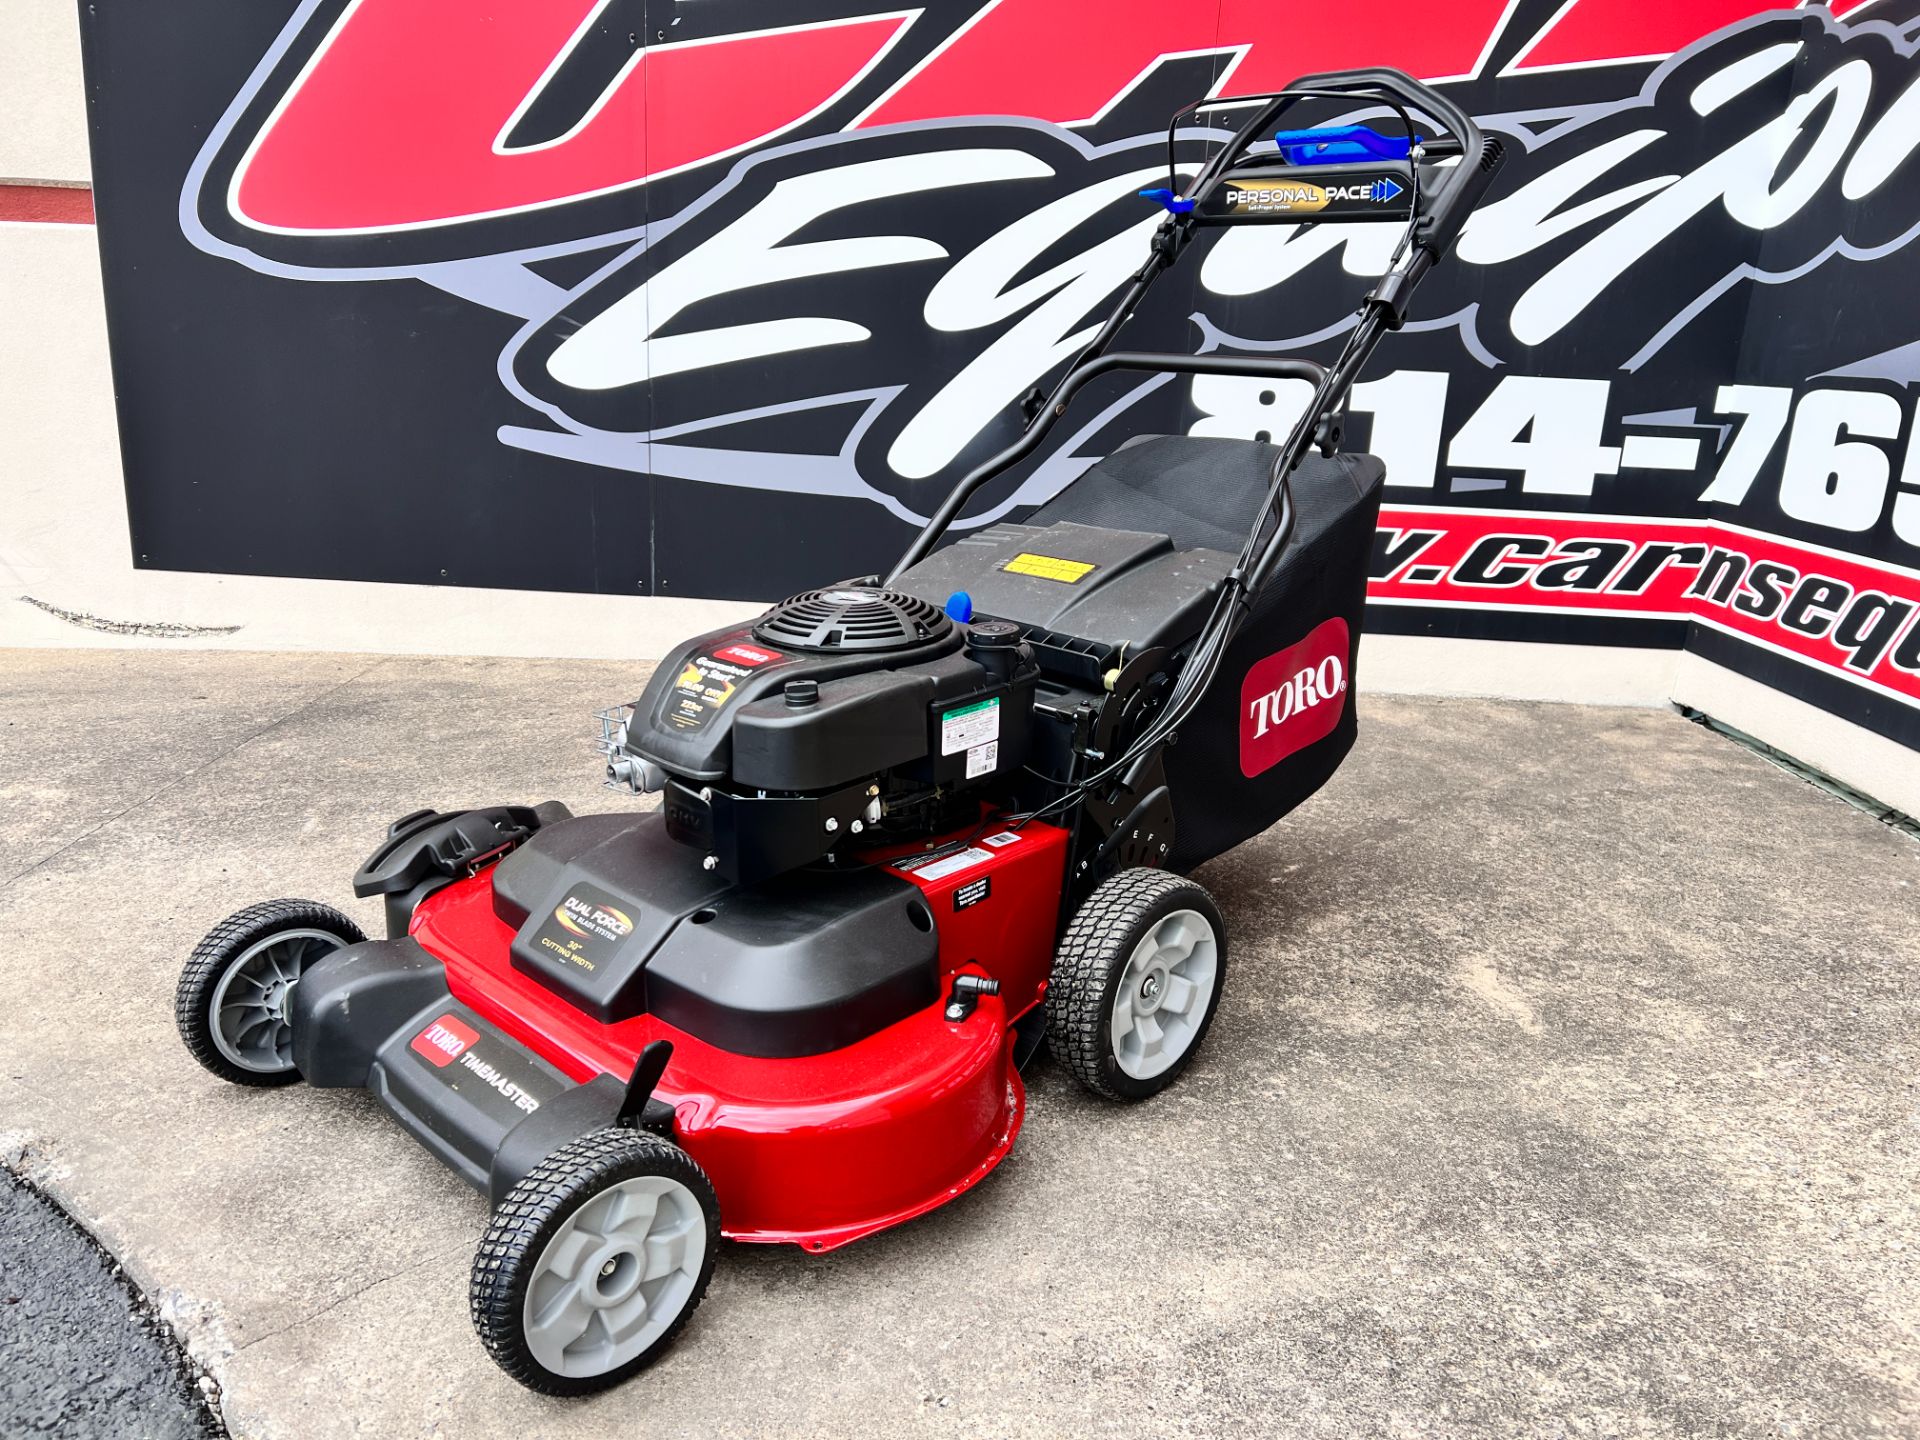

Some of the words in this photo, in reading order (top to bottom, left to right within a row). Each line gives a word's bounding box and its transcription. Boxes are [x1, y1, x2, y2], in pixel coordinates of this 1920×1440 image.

[1226, 187, 1318, 205] PERSONAL
[1324, 185, 1373, 201] PACE
[1188, 368, 1920, 548] 814-76
[726, 647, 770, 663] TORO
[1133, 829, 1139, 839] E
[1147, 833, 1154, 841] F
[564, 896, 592, 917] DUAL
[590, 910, 629, 935] FORCE
[594, 926, 617, 942] SYSTEM
[541, 937, 571, 958] CUTTING
[570, 953, 596, 972] WIDTH
[424, 1023, 465, 1057] TORO
[460, 1051, 540, 1115] TIMEMASTER
